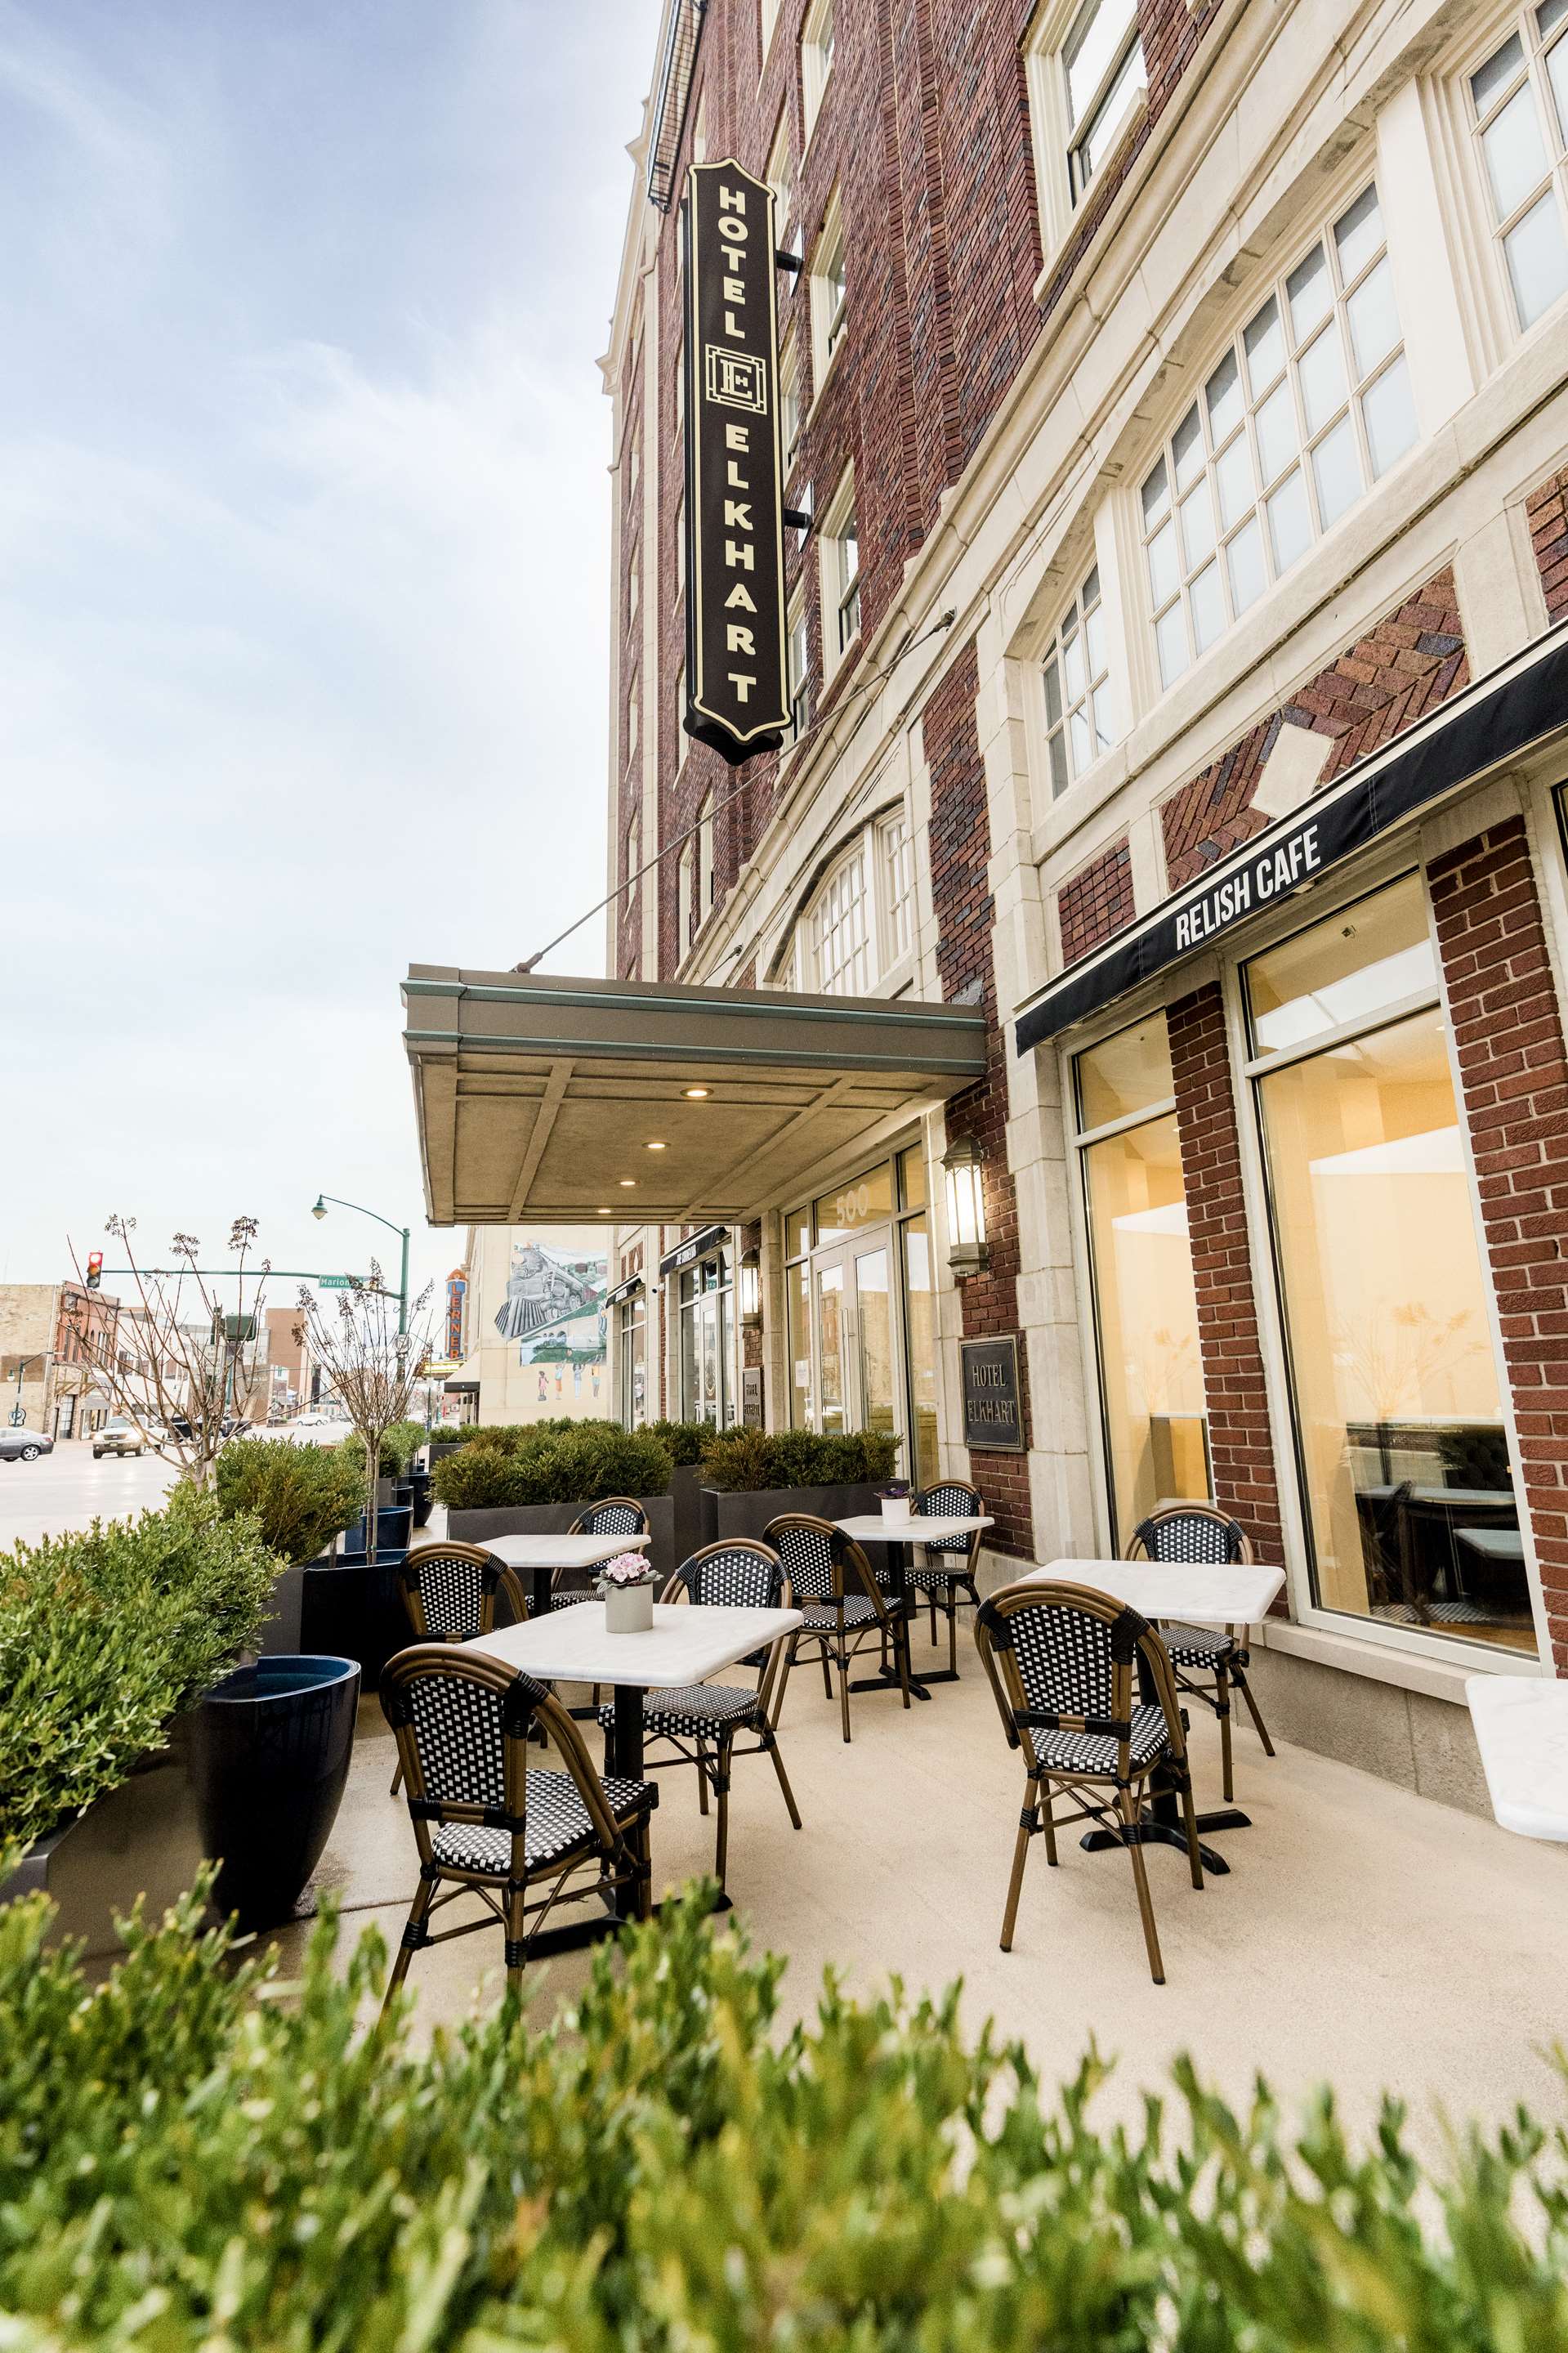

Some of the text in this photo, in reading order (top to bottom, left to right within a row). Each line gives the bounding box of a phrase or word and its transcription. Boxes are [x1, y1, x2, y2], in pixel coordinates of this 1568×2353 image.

[717, 185, 749, 339] HOTEL
[724, 423, 758, 704] ELKHART
[1176, 824, 1321, 951] RELISH CAFE
[837, 1183, 869, 1227] 500
[450, 1283, 461, 1358] LERNER
[967, 1399, 1015, 1425] ELKHART
[972, 1364, 1006, 1387] HOTEL
